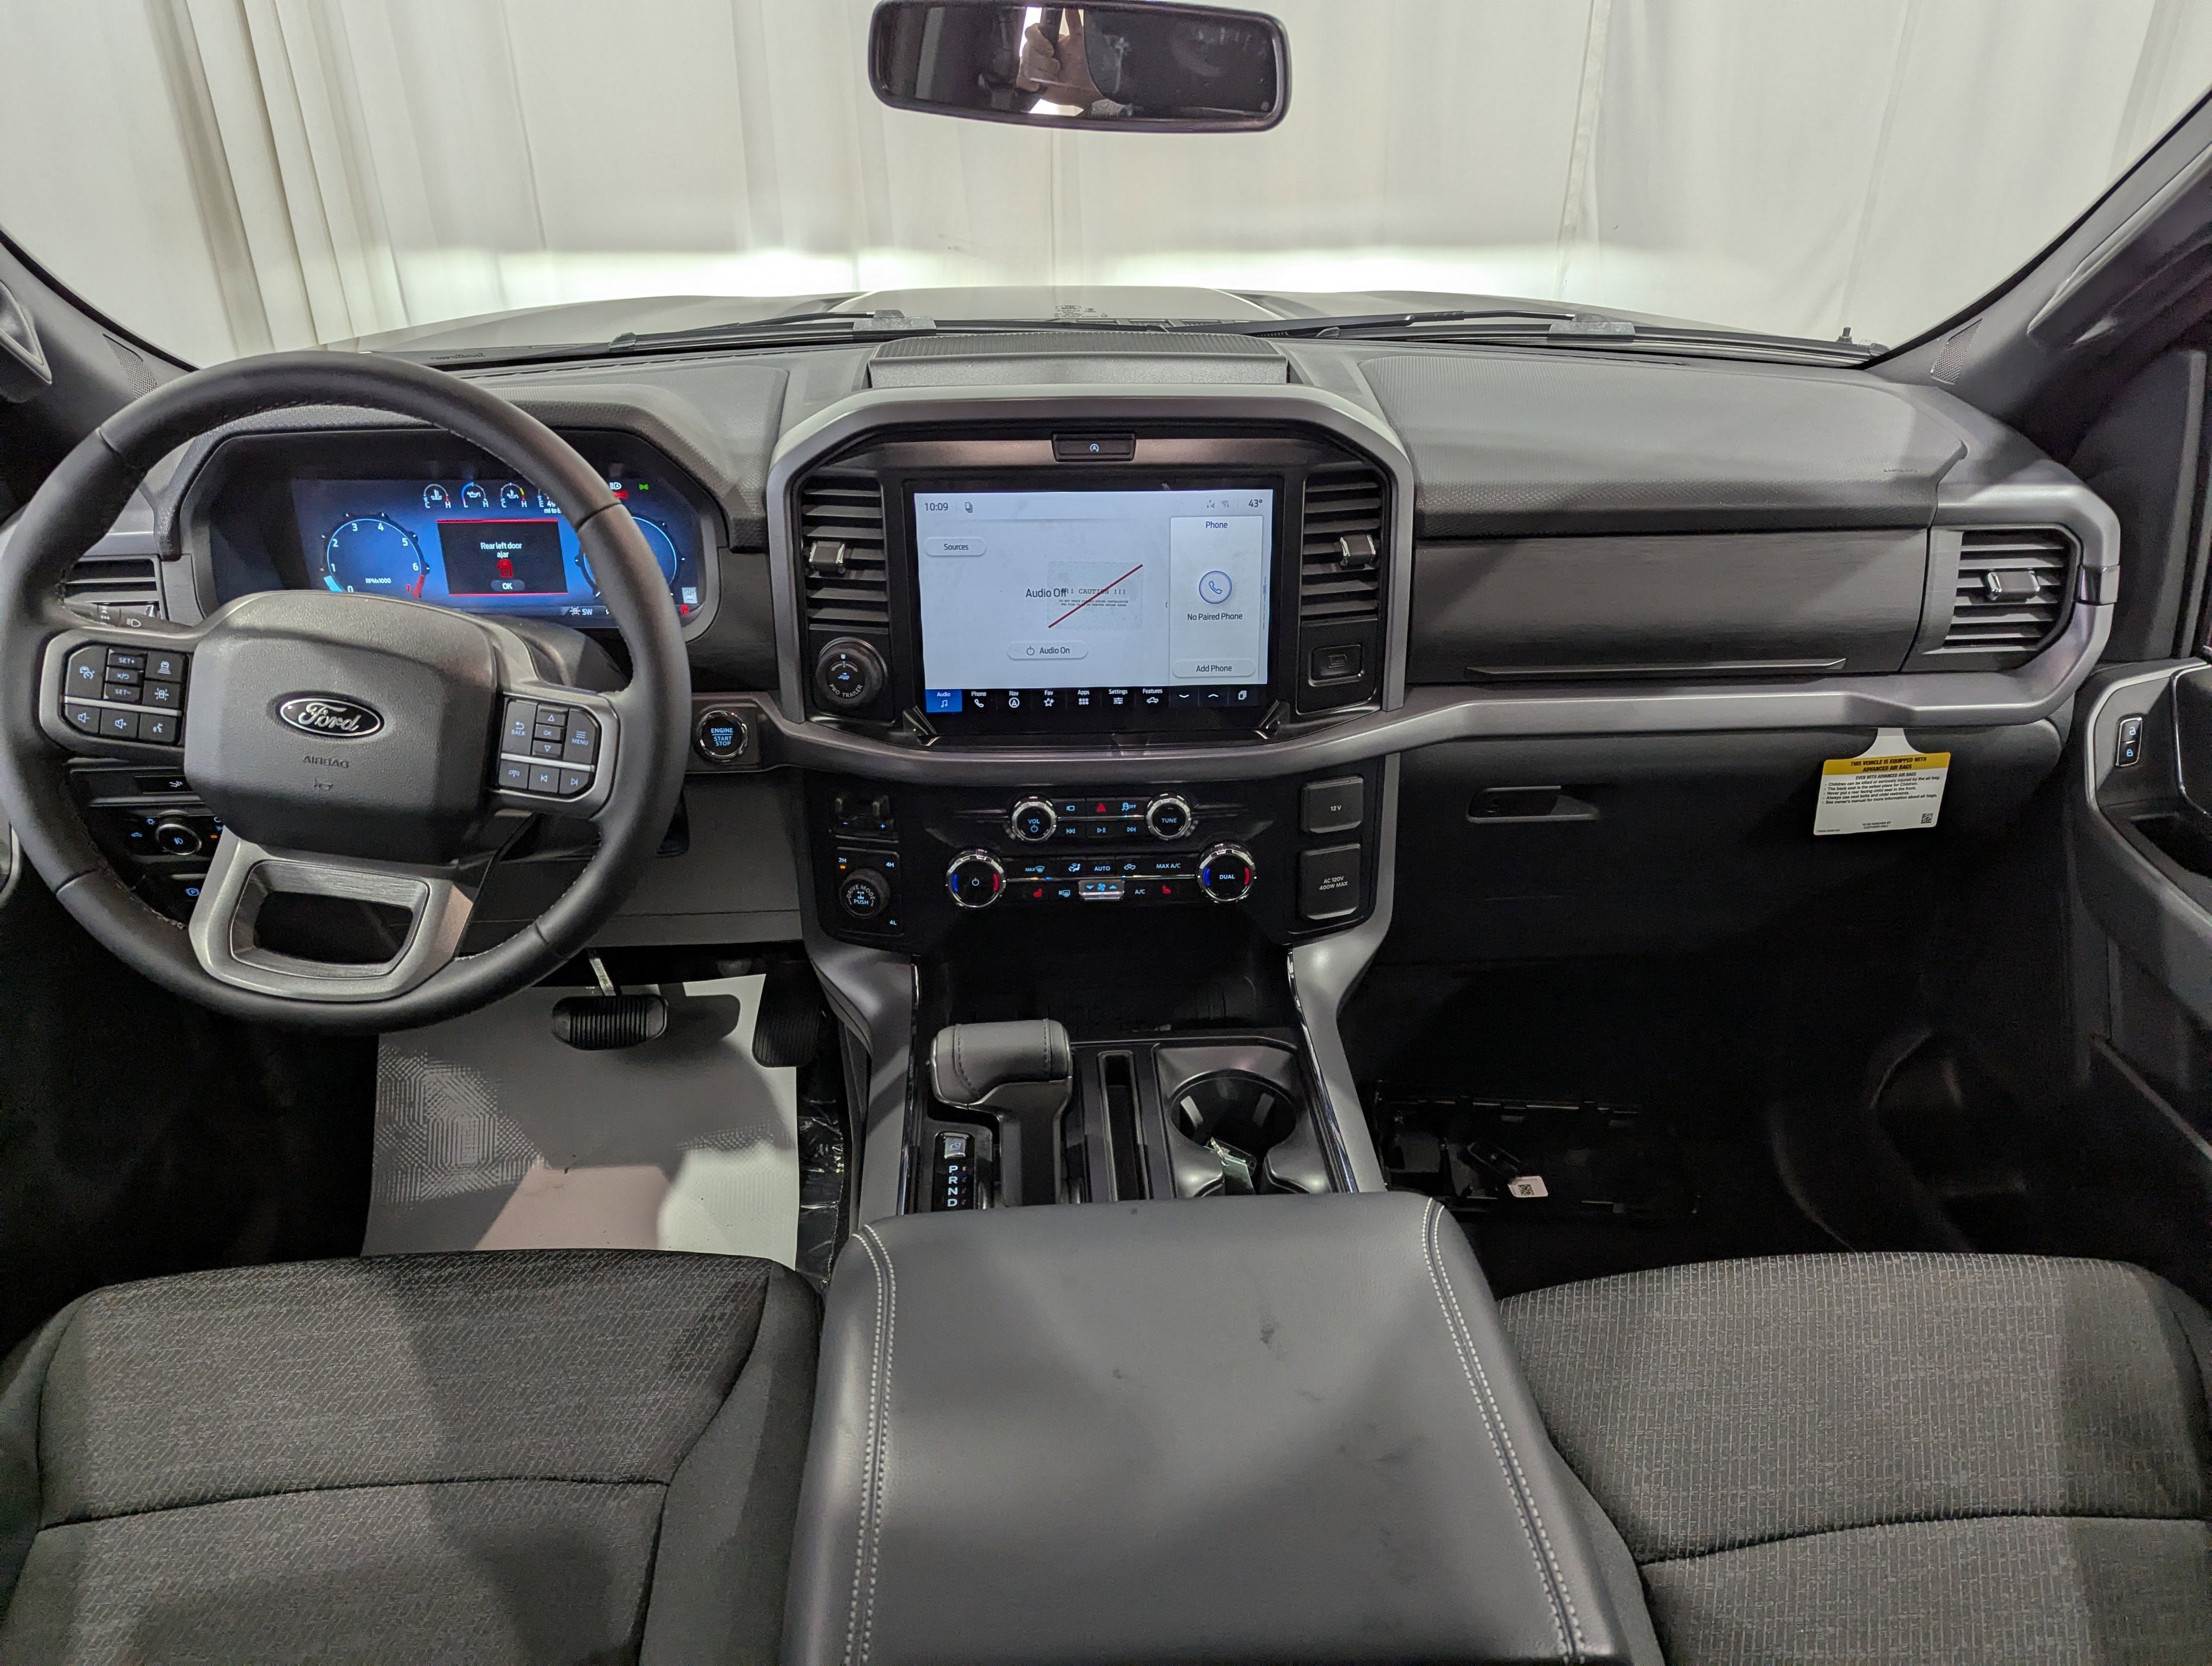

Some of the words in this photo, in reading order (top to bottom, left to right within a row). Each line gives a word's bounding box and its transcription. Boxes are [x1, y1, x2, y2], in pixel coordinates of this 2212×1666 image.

[924, 503, 948, 511] 10:09
[1249, 499, 1263, 508] 43°
[352, 523, 358, 531] 3
[378, 523, 384, 531] 4
[332, 539, 338, 547] 2
[402, 538, 408, 546] 5
[331, 563, 336, 572] 1
[1026, 588, 1051, 598] Audio
[1053, 588, 1067, 598] Off
[829, 684, 840, 695] PRO
[842, 684, 863, 697] TRAILER
[298, 702, 361, 731] Ford
[847, 885, 859, 898] DRIVE
[860, 885, 875, 899] MODE
[948, 1187, 958, 1195] N
[947, 1199, 958, 1207] D
